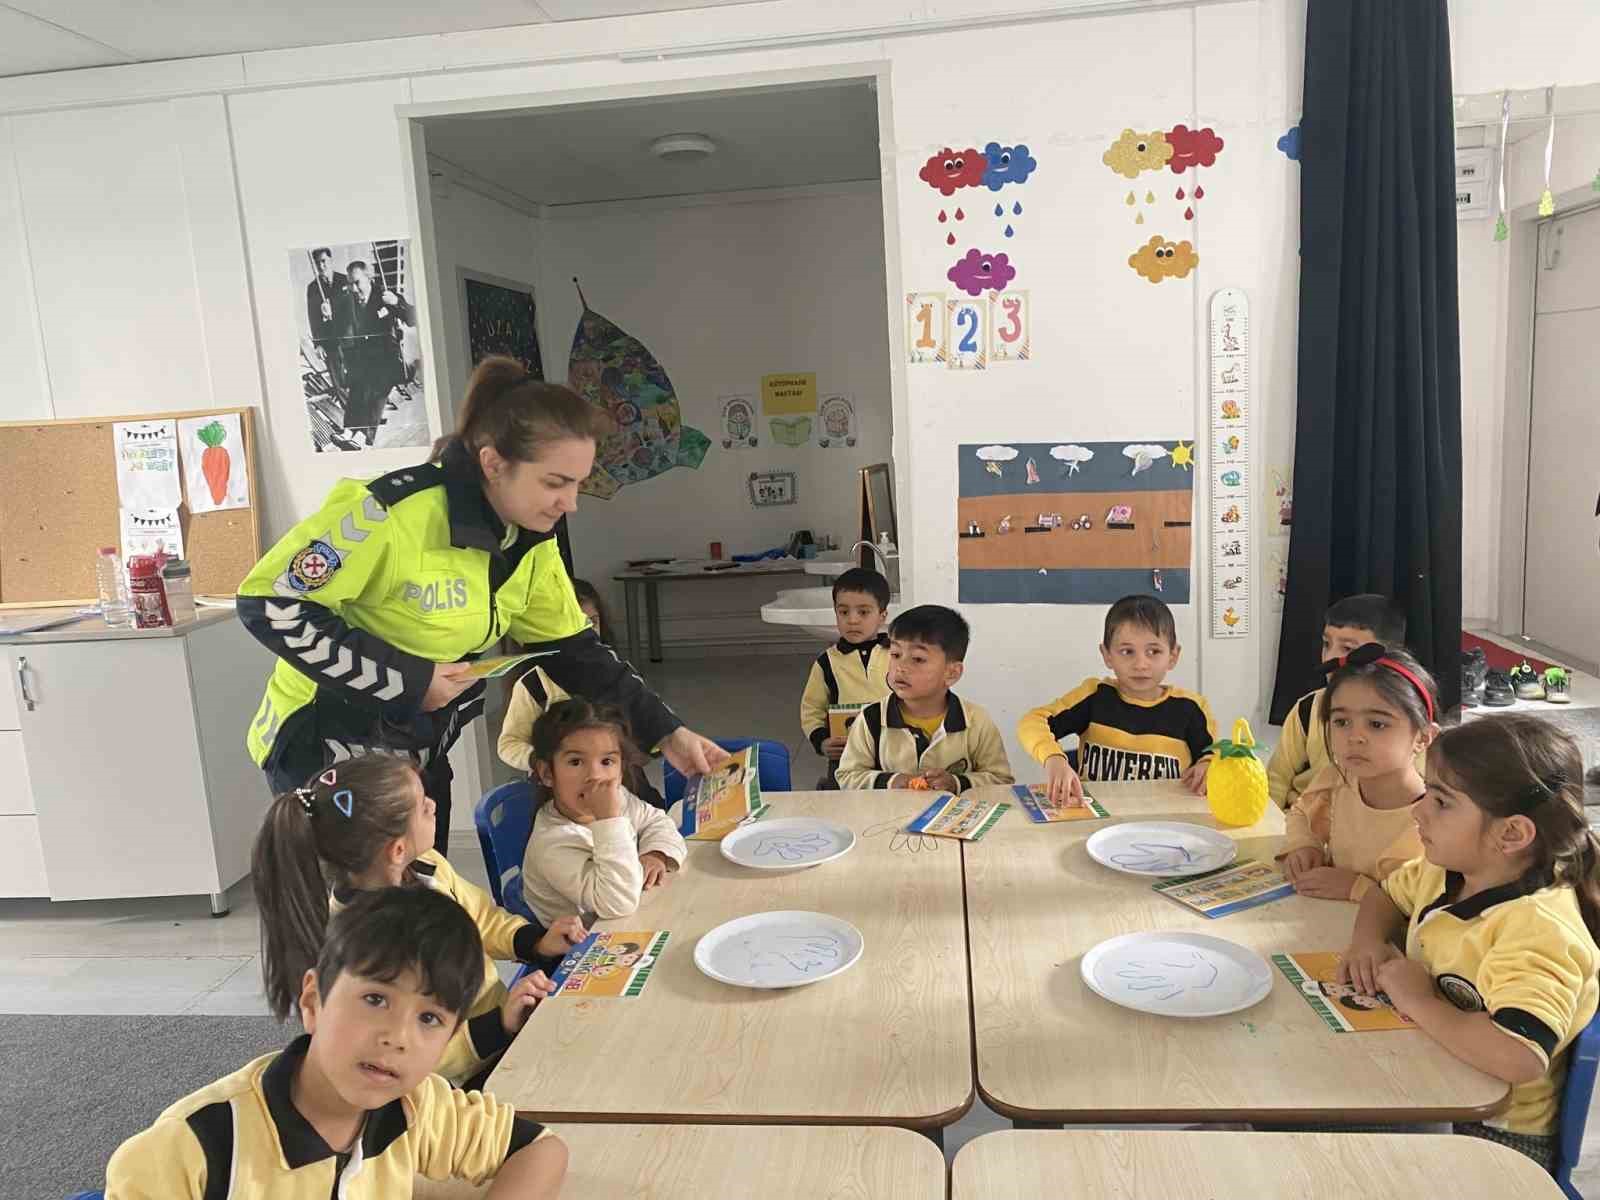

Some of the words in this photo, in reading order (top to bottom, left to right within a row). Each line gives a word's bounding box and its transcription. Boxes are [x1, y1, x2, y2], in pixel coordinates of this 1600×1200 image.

[916, 303, 936, 348] 1
[957, 307, 978, 352] 2
[998, 298, 1021, 343] 3
